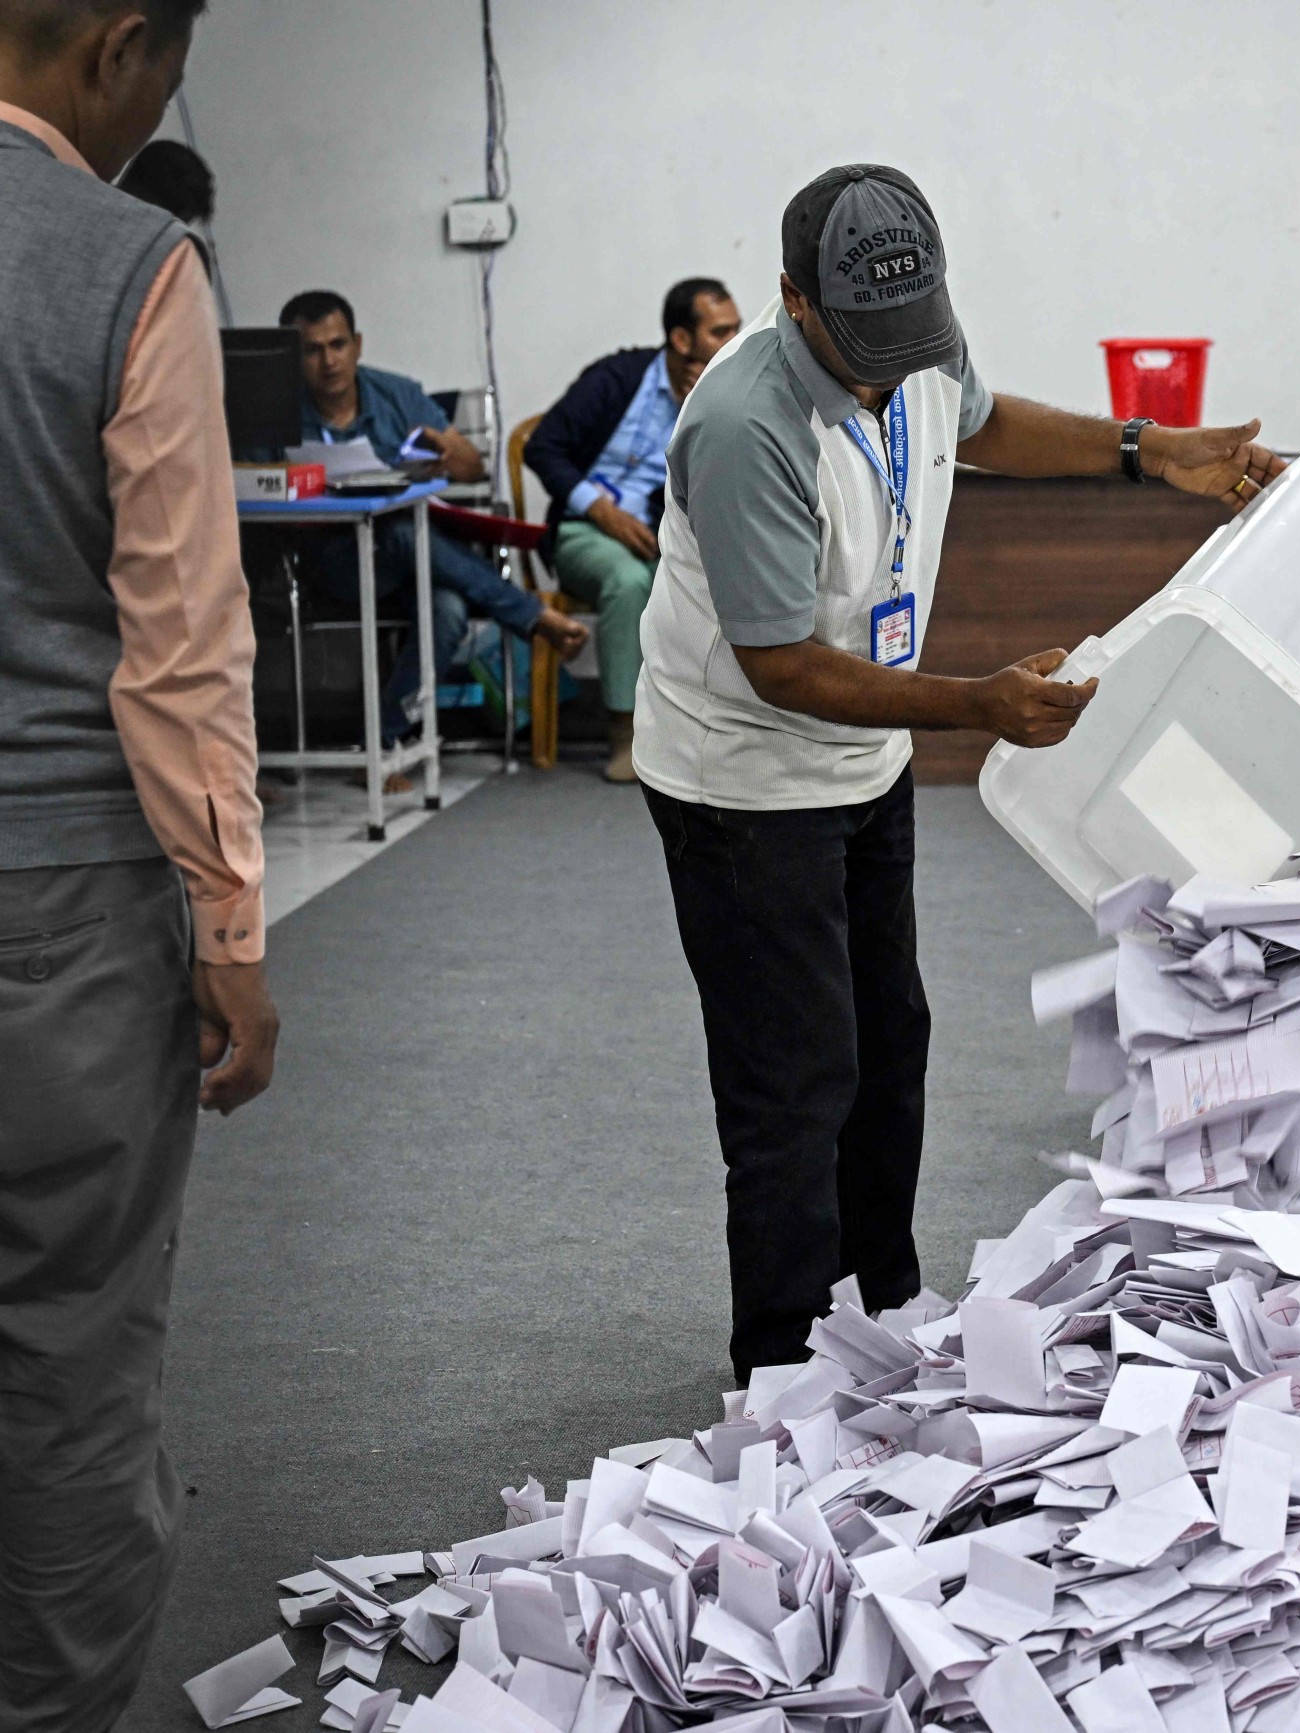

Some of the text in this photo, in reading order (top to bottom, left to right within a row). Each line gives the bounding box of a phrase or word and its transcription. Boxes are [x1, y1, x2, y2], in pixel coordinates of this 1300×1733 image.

[836, 228, 934, 277] BROSVILLE
[874, 255, 915, 279] NYS
[852, 274, 865, 286] 49
[878, 274, 935, 301] FORWARD
